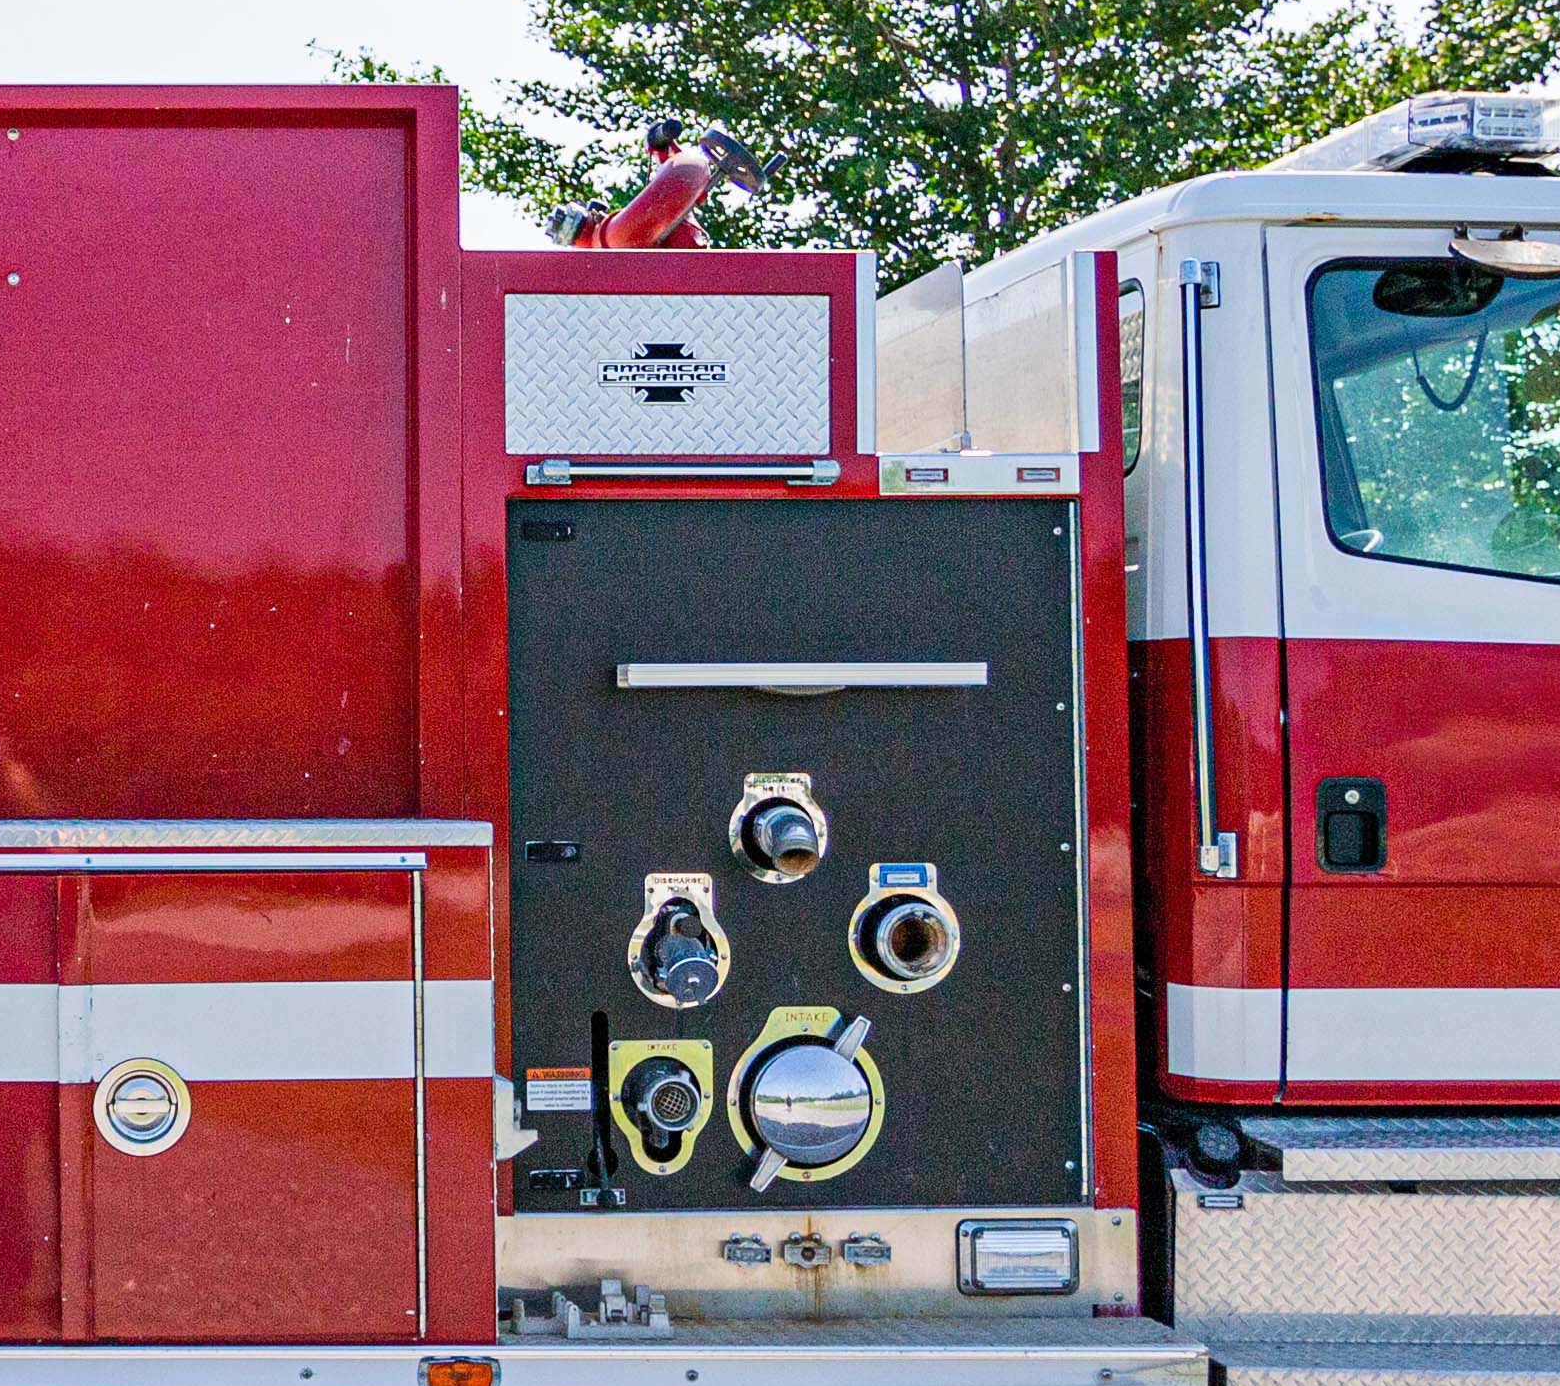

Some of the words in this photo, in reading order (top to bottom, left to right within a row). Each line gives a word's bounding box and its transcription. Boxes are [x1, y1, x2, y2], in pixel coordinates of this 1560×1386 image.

[602, 364, 726, 373] AMERICAN
[785, 1012, 829, 1022] INTAKE
[543, 1070, 586, 1079] WARNING
